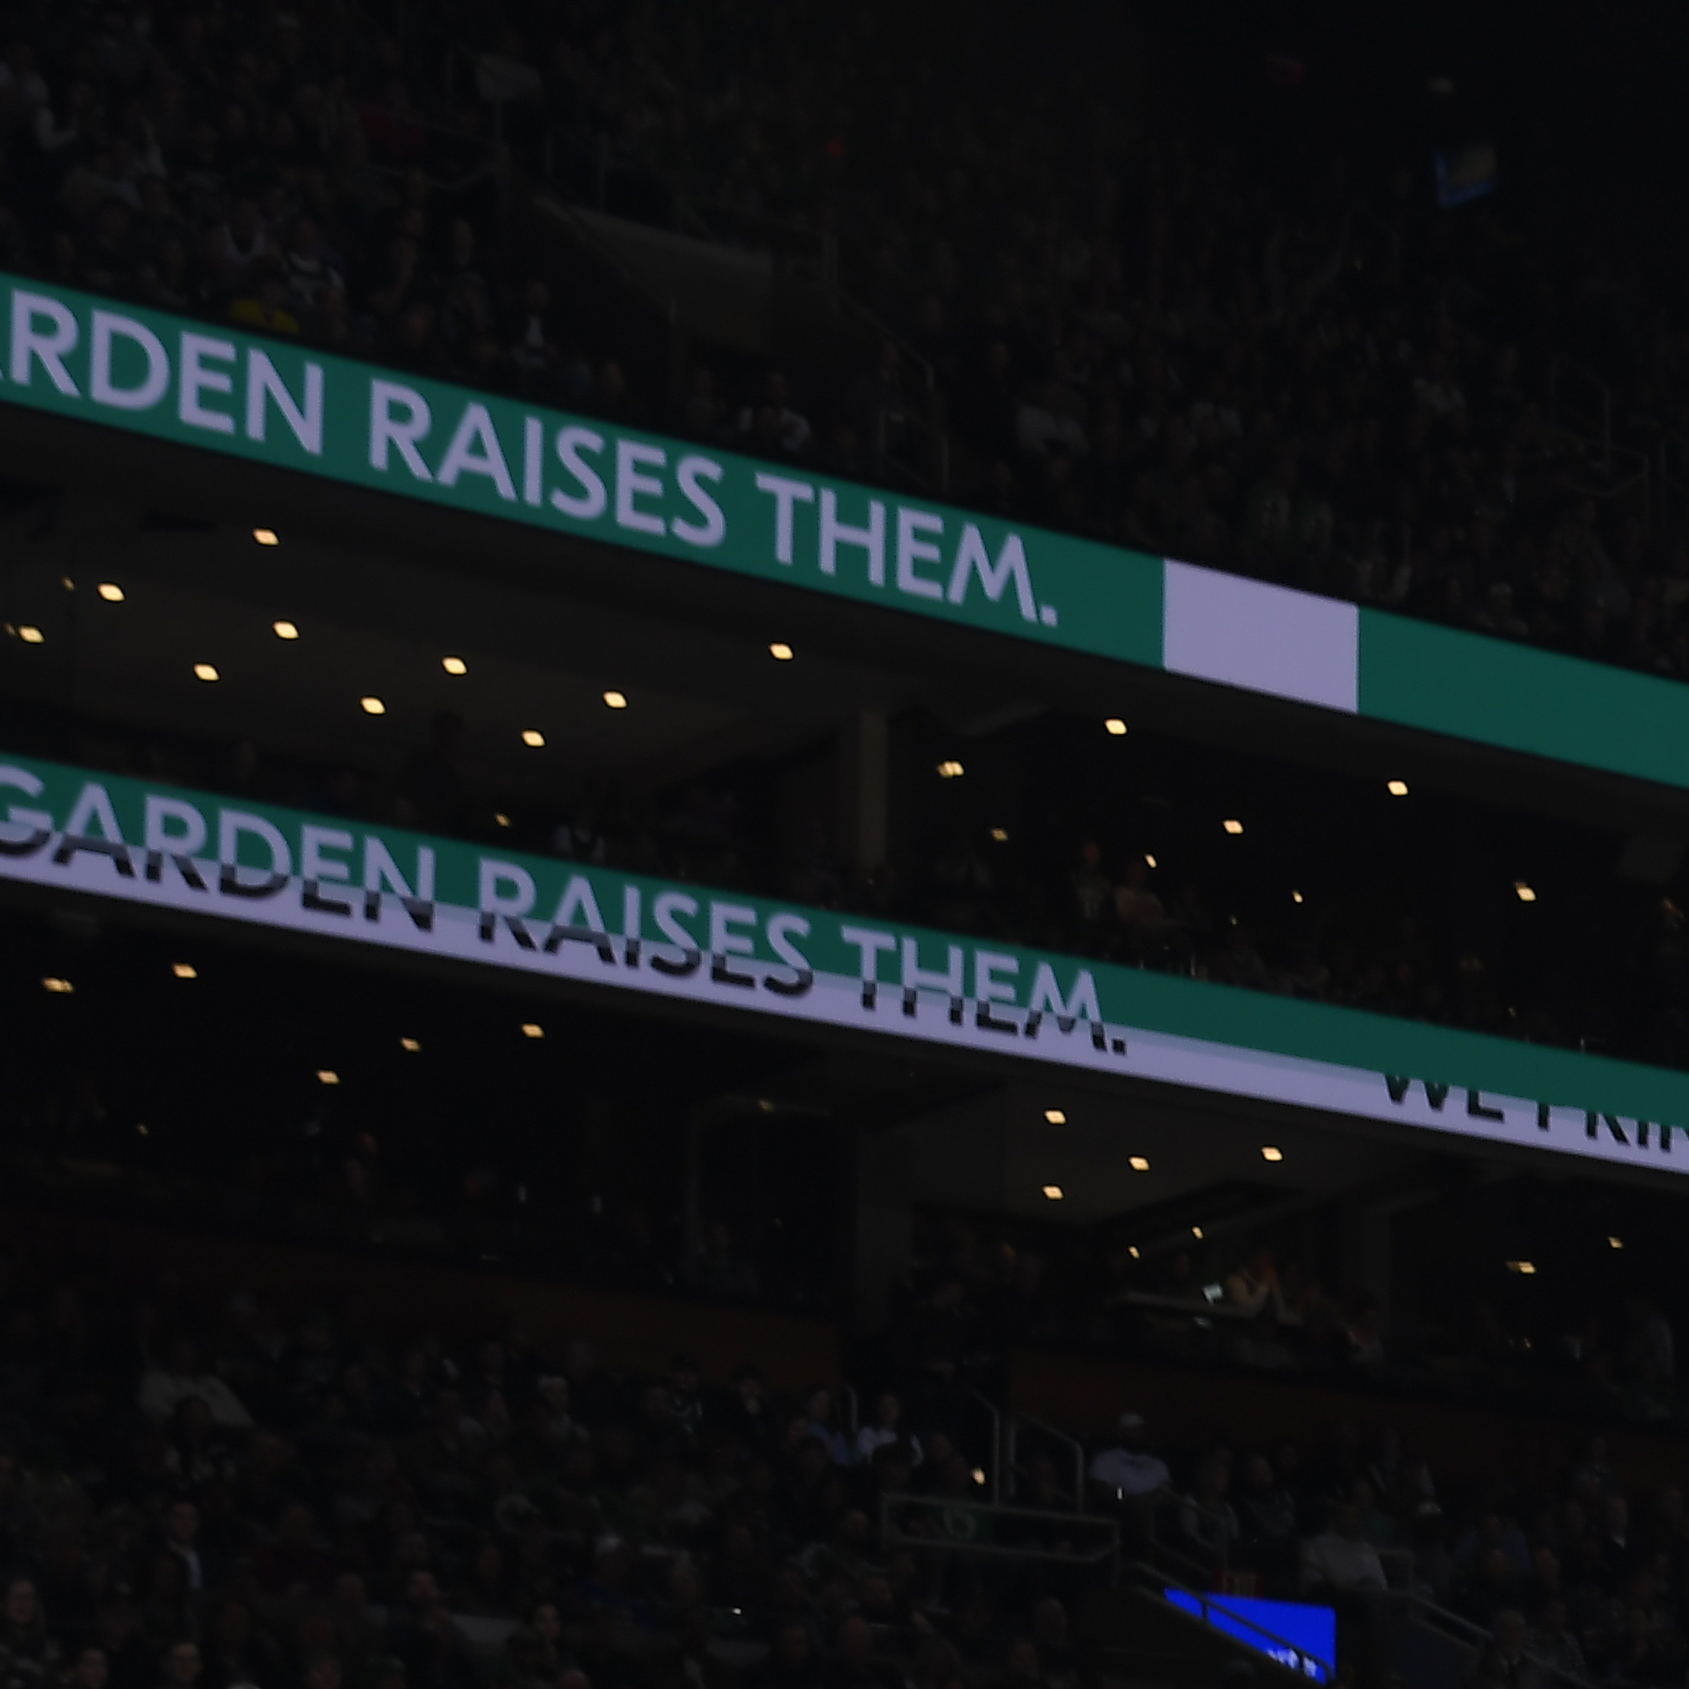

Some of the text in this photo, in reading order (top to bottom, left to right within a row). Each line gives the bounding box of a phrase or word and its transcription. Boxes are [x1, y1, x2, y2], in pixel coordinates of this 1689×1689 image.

[0, 291, 1058, 626] RDEN RAISES THEM.
[479, 856, 815, 995] RAISES
[841, 925, 1128, 1056] THEM.
